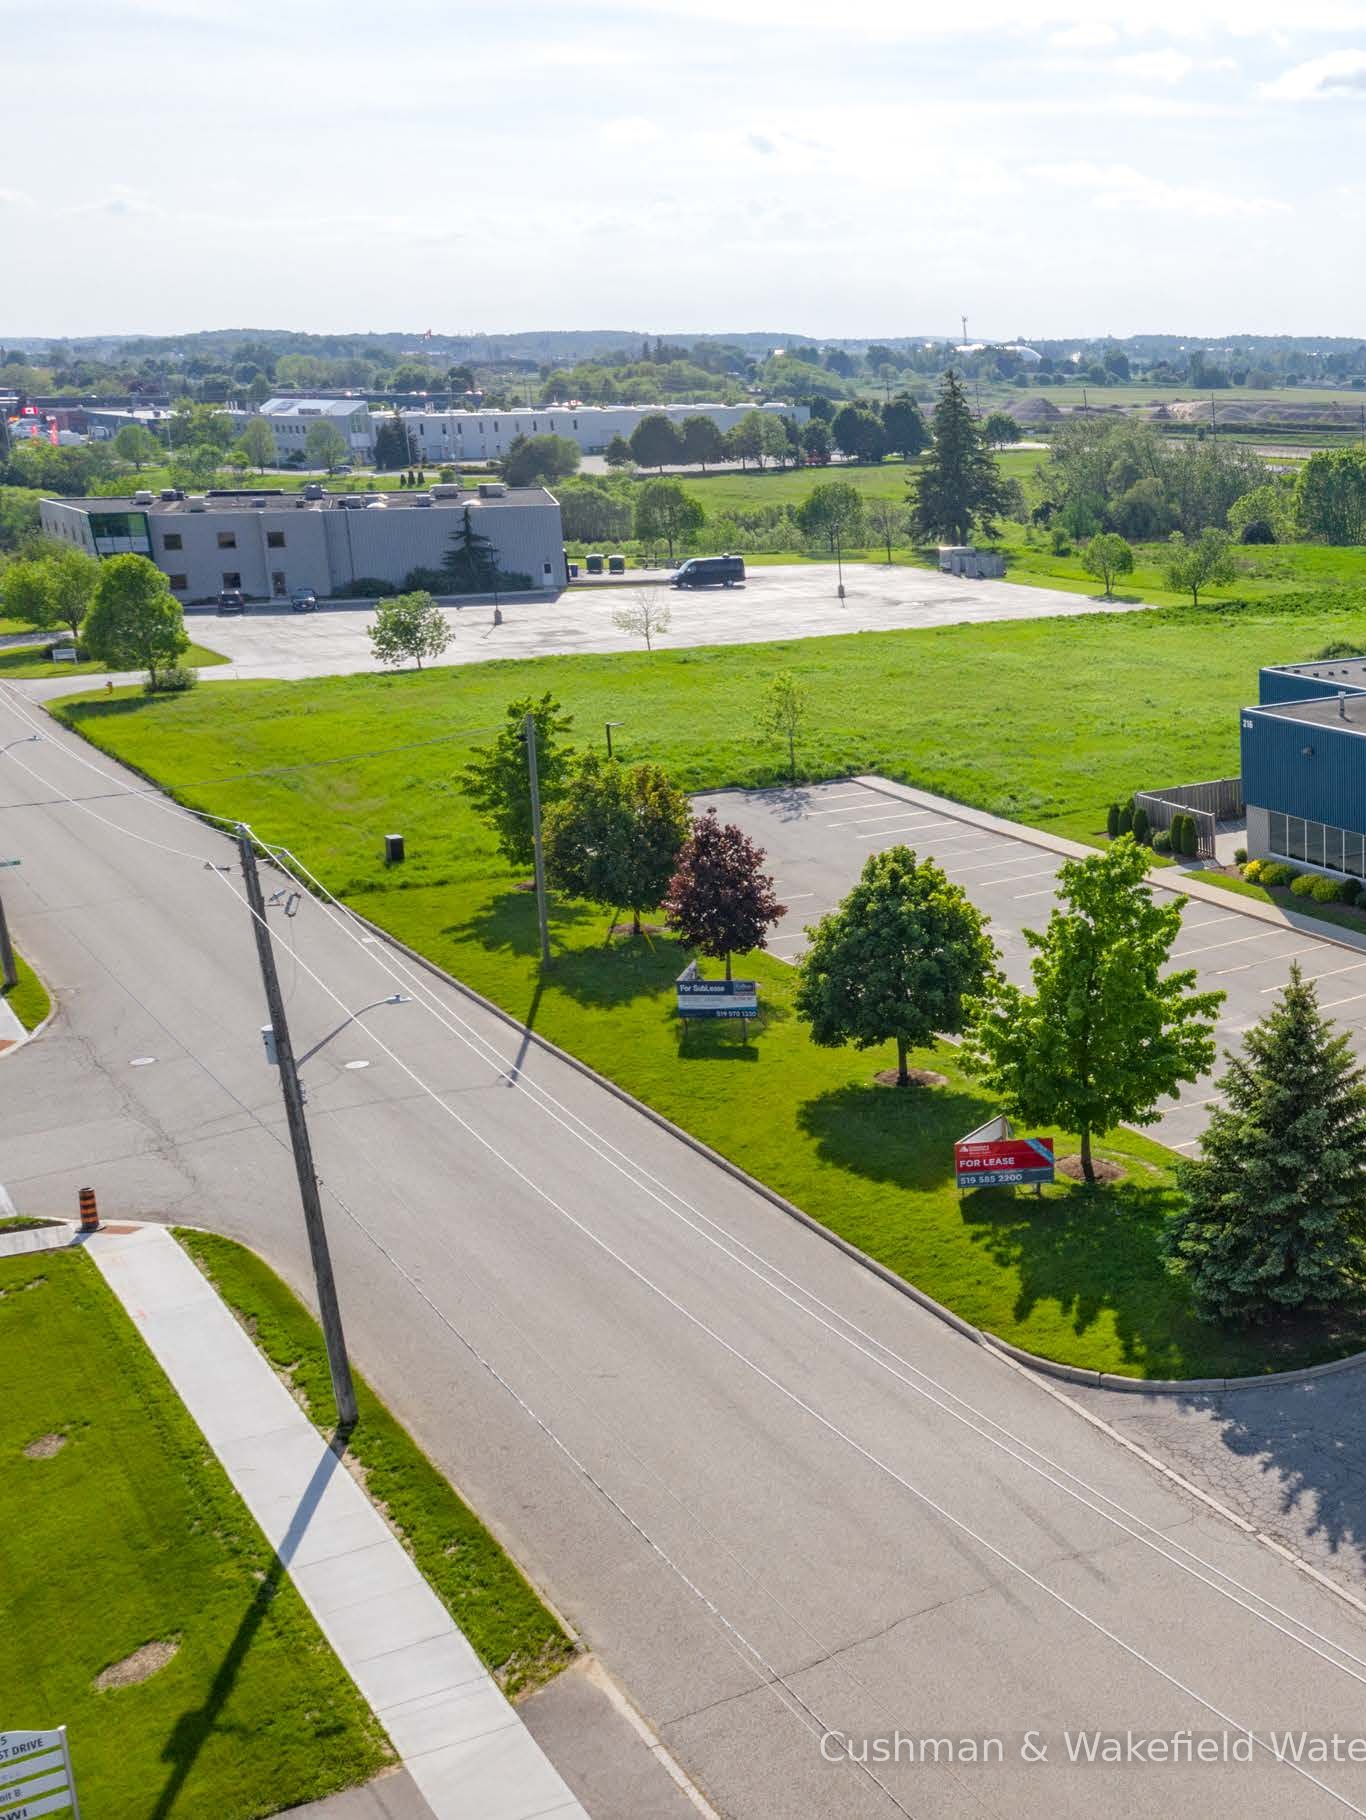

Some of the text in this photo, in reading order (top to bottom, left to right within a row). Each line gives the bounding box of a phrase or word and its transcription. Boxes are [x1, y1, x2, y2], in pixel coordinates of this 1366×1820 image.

[680, 984, 692, 992] For
[983, 1157, 1015, 1166] LEASE
[999, 1174, 1022, 1182] 2200
[12, 1738, 44, 1755] DRIVE
